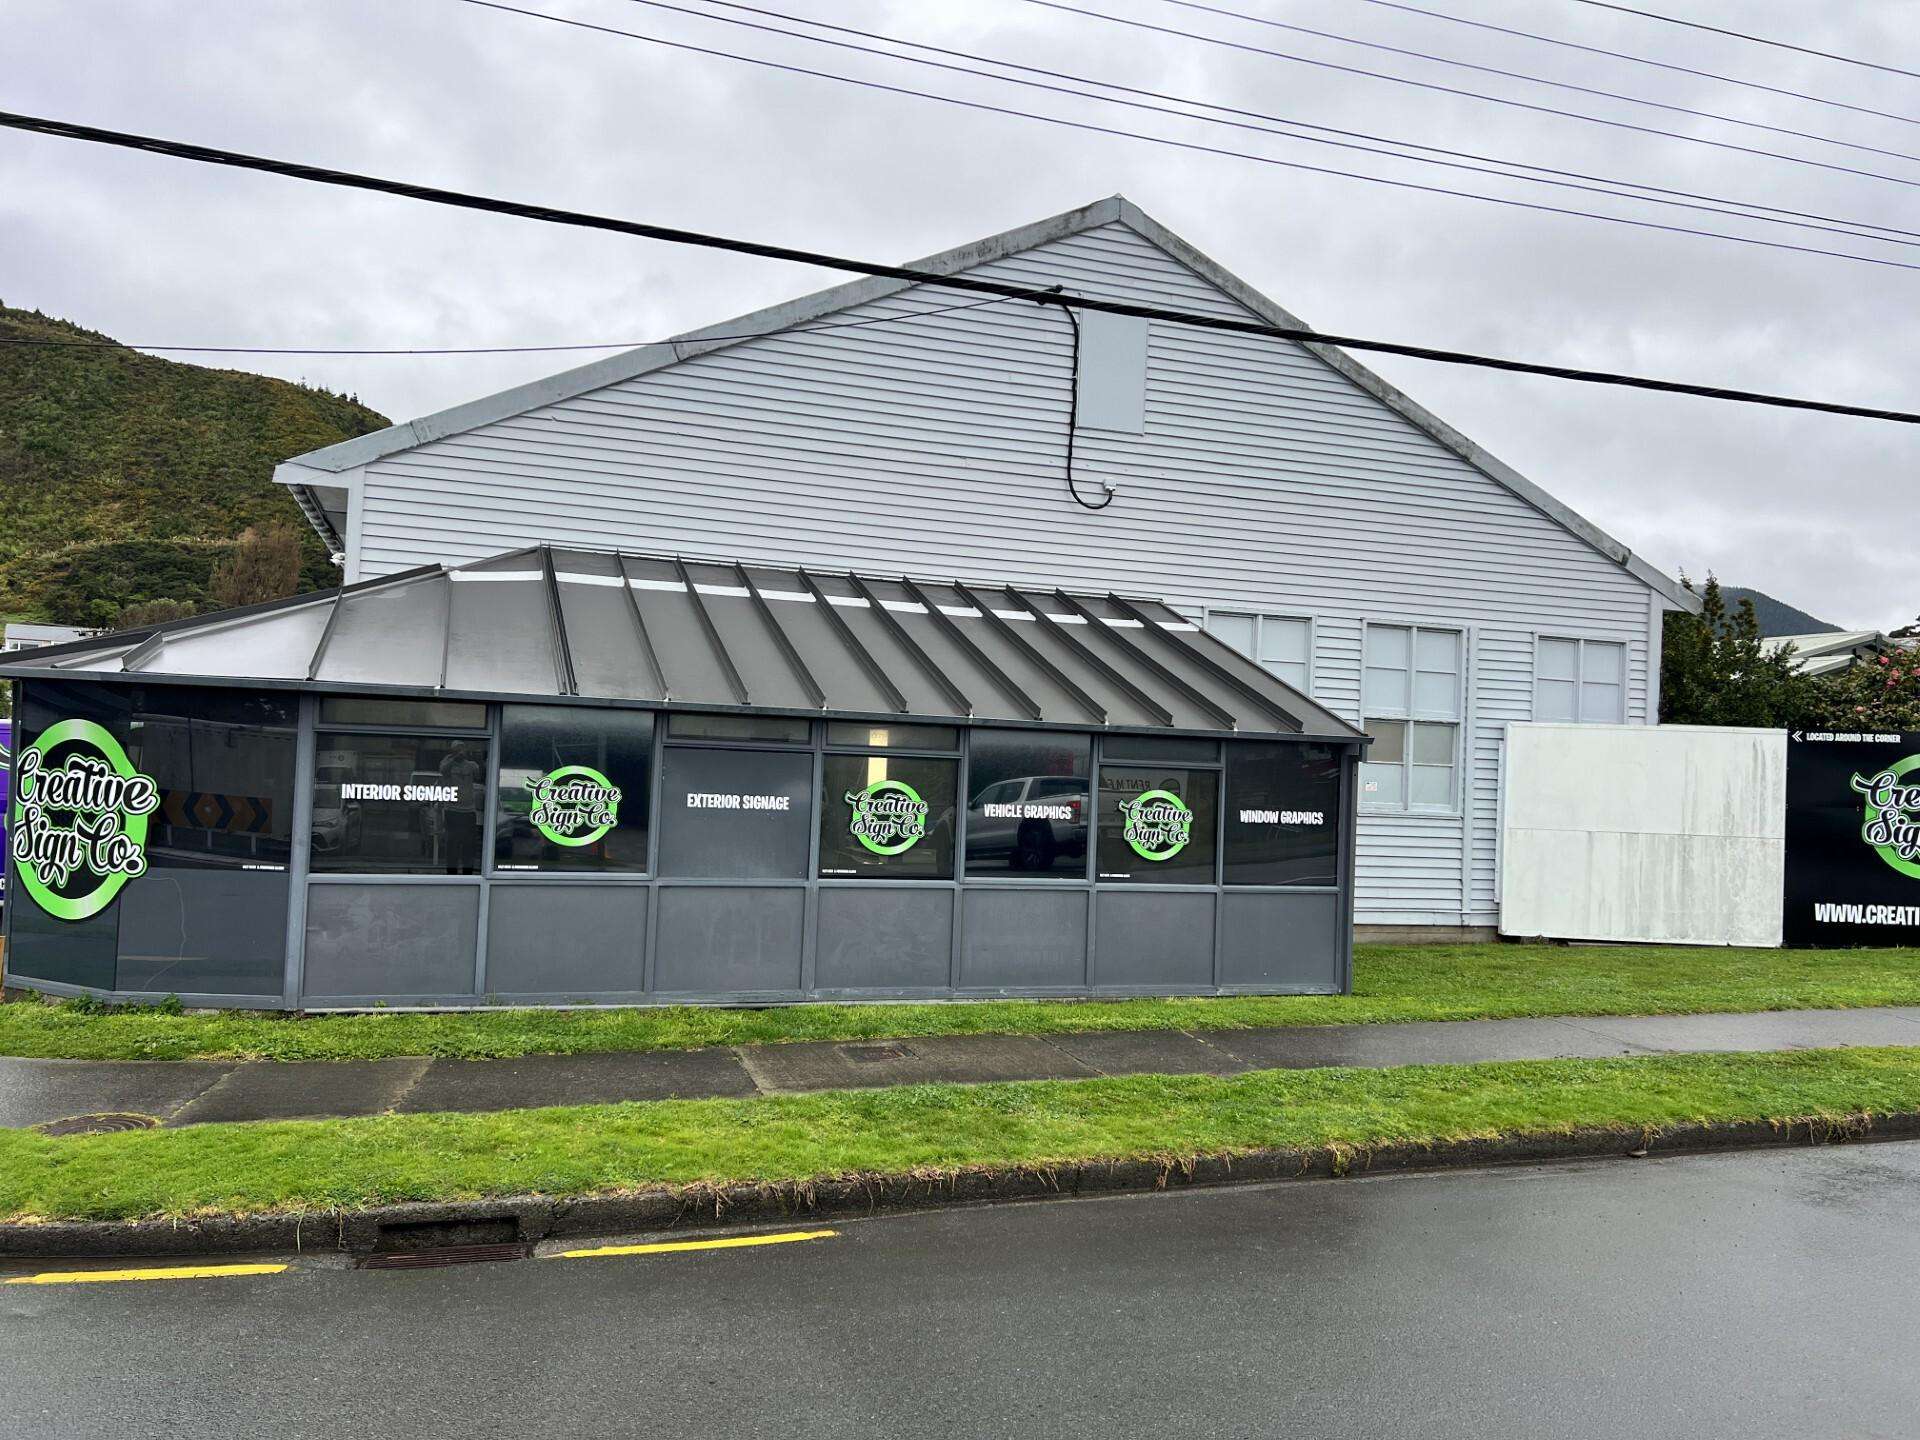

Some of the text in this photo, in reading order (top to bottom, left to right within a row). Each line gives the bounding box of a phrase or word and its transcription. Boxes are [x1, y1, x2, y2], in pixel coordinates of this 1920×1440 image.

[1806, 732, 1901, 744] LOCATED AROUND THE CORNER
[15, 747, 160, 815] Creative
[341, 783, 459, 803] INTERIOR SIGNAGE
[526, 776, 622, 804] Creative
[687, 793, 790, 811] EXTERIOR SIGNAGE
[845, 789, 929, 816] Creative
[983, 803, 1072, 820] VEHICLE GRAPHICS
[1118, 799, 1193, 823] Creative
[529, 800, 616, 834] Sign Co.
[850, 812, 927, 844] Sign Co.
[1239, 809, 1324, 825] WINDOW GRAPHICS
[14, 804, 147, 887] Sign Co.
[1123, 821, 1190, 850] Sign Co.
[1814, 903, 1920, 926] WWW.CREATI
